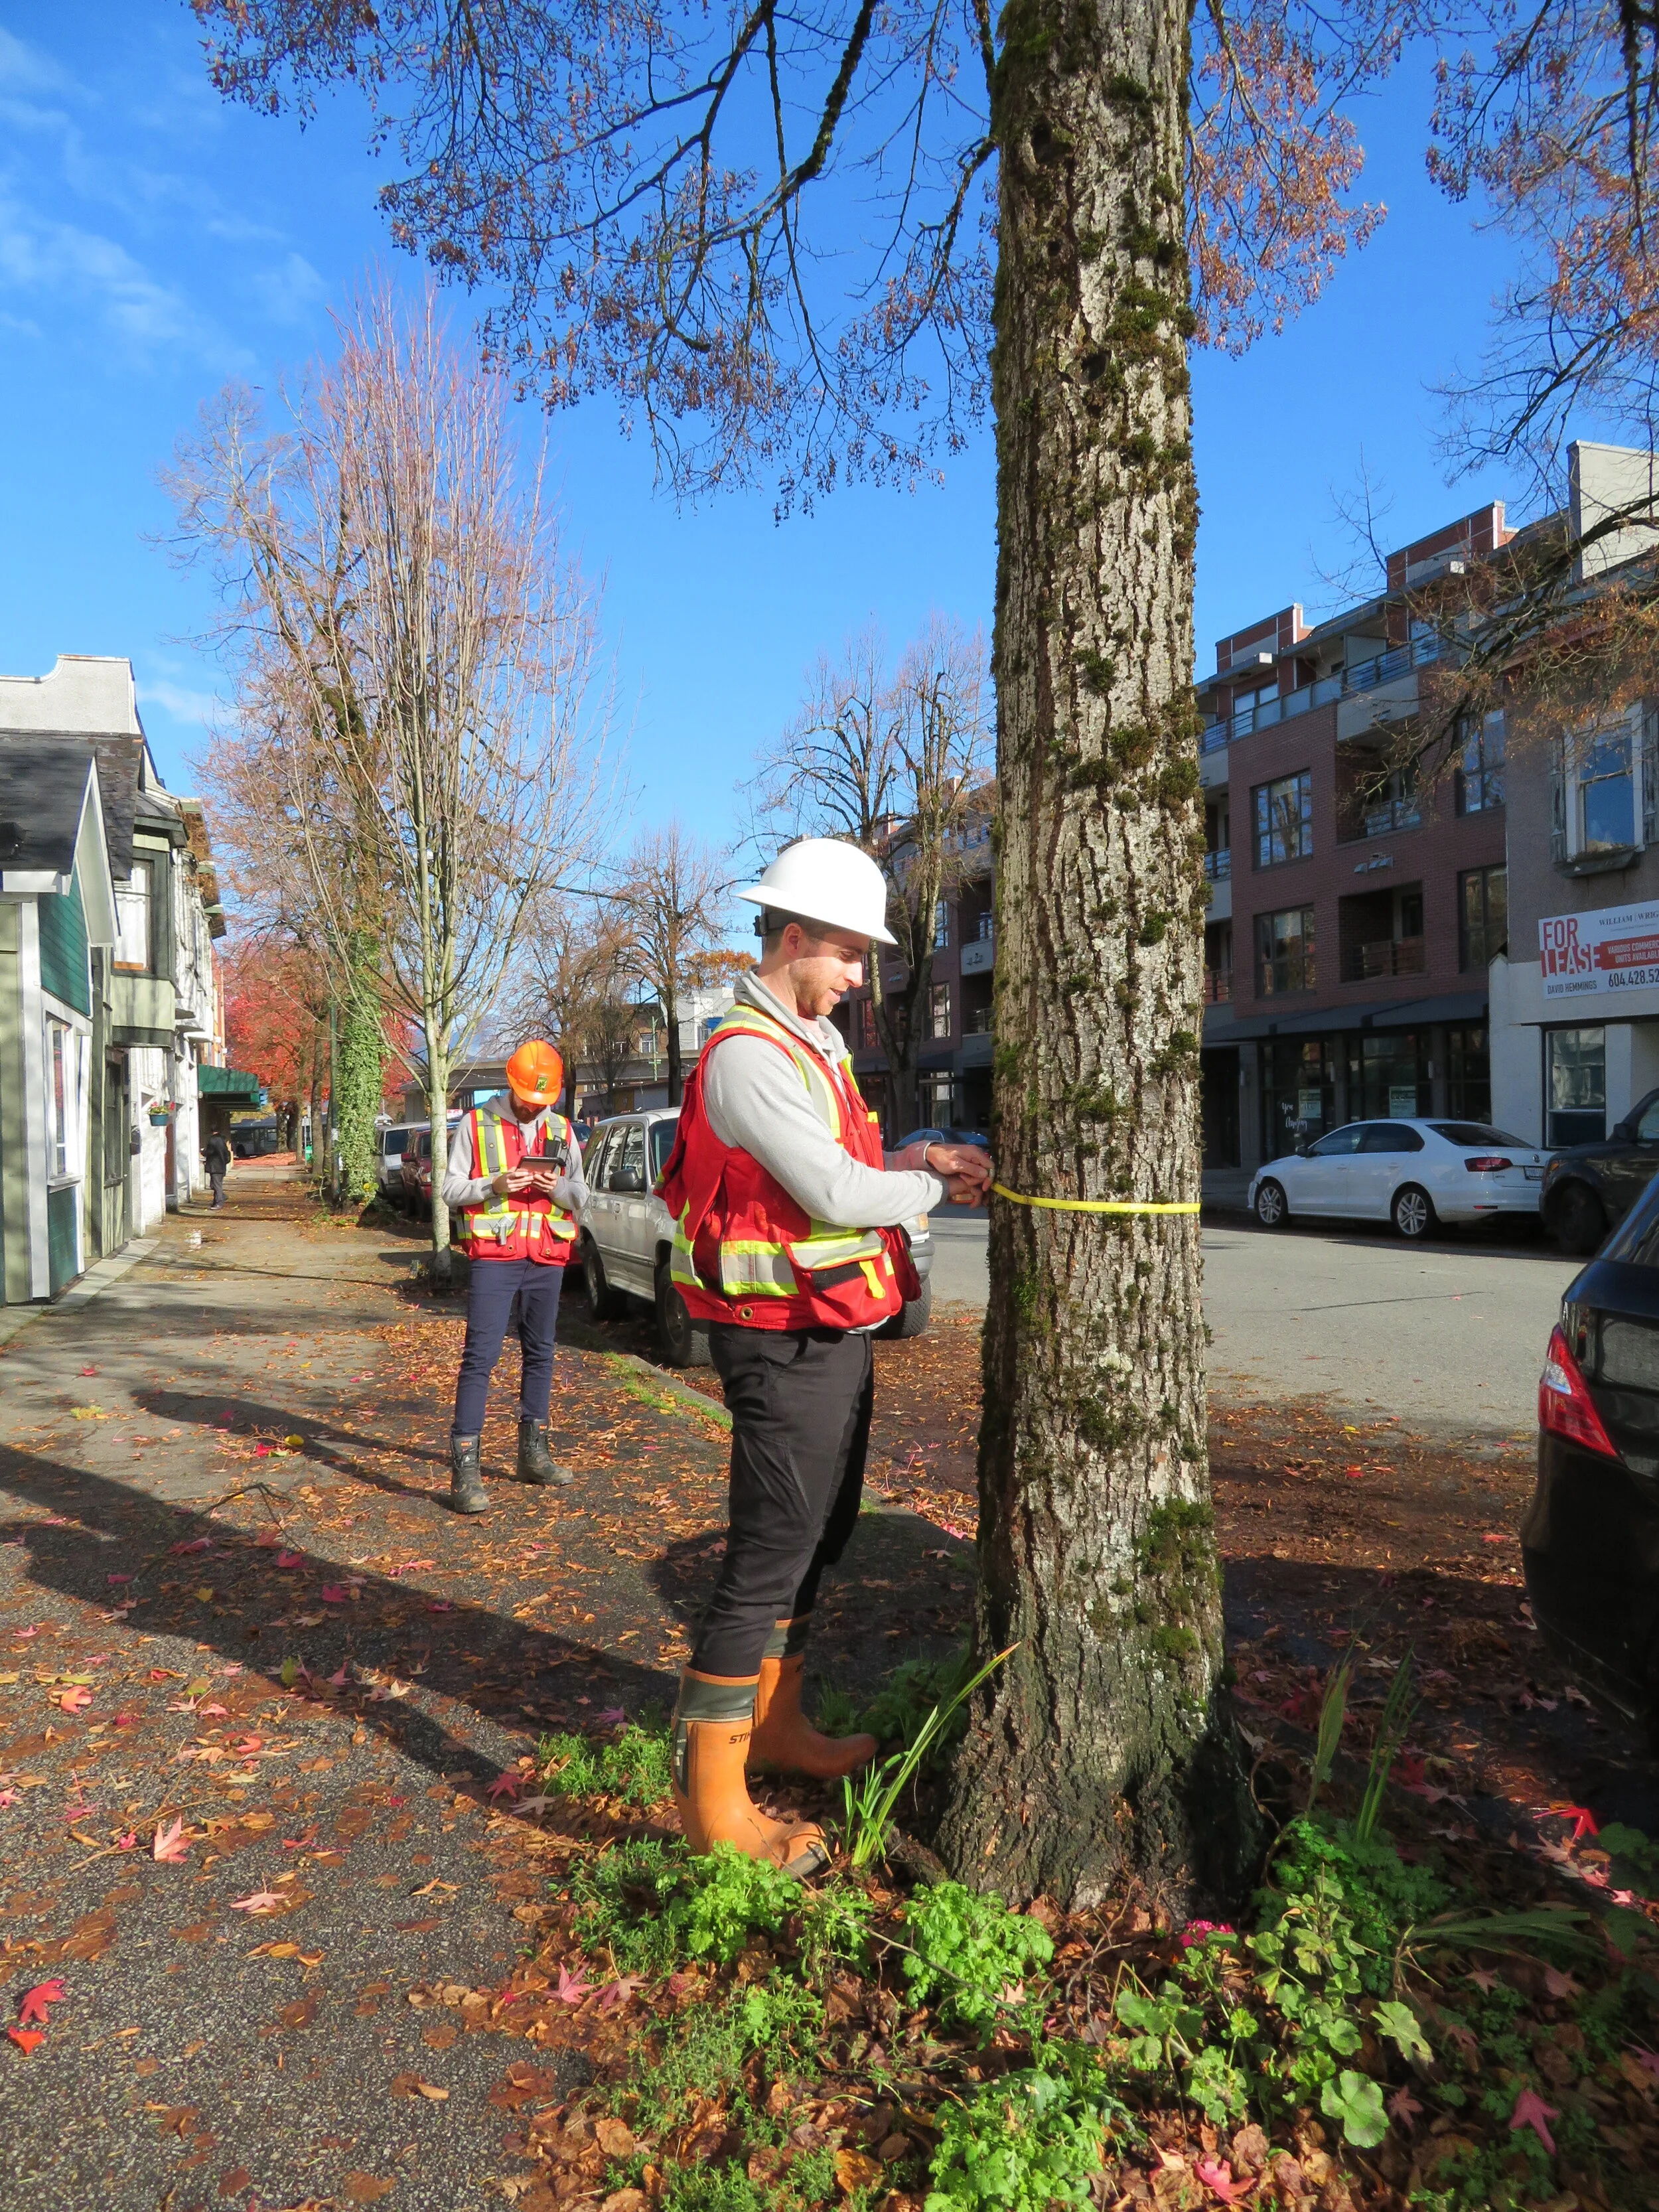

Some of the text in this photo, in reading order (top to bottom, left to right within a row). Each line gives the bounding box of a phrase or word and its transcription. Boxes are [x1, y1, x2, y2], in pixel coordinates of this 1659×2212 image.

[1599, 915, 1632, 926] WILLIAM
[1543, 918, 1579, 950] FOR
[1608, 944, 1630, 954] VARIOUS
[1545, 944, 1601, 977] LEASE
[1615, 954, 1632, 963] UNITS
[1548, 980, 1597, 994] DAVID HEMMINGS
